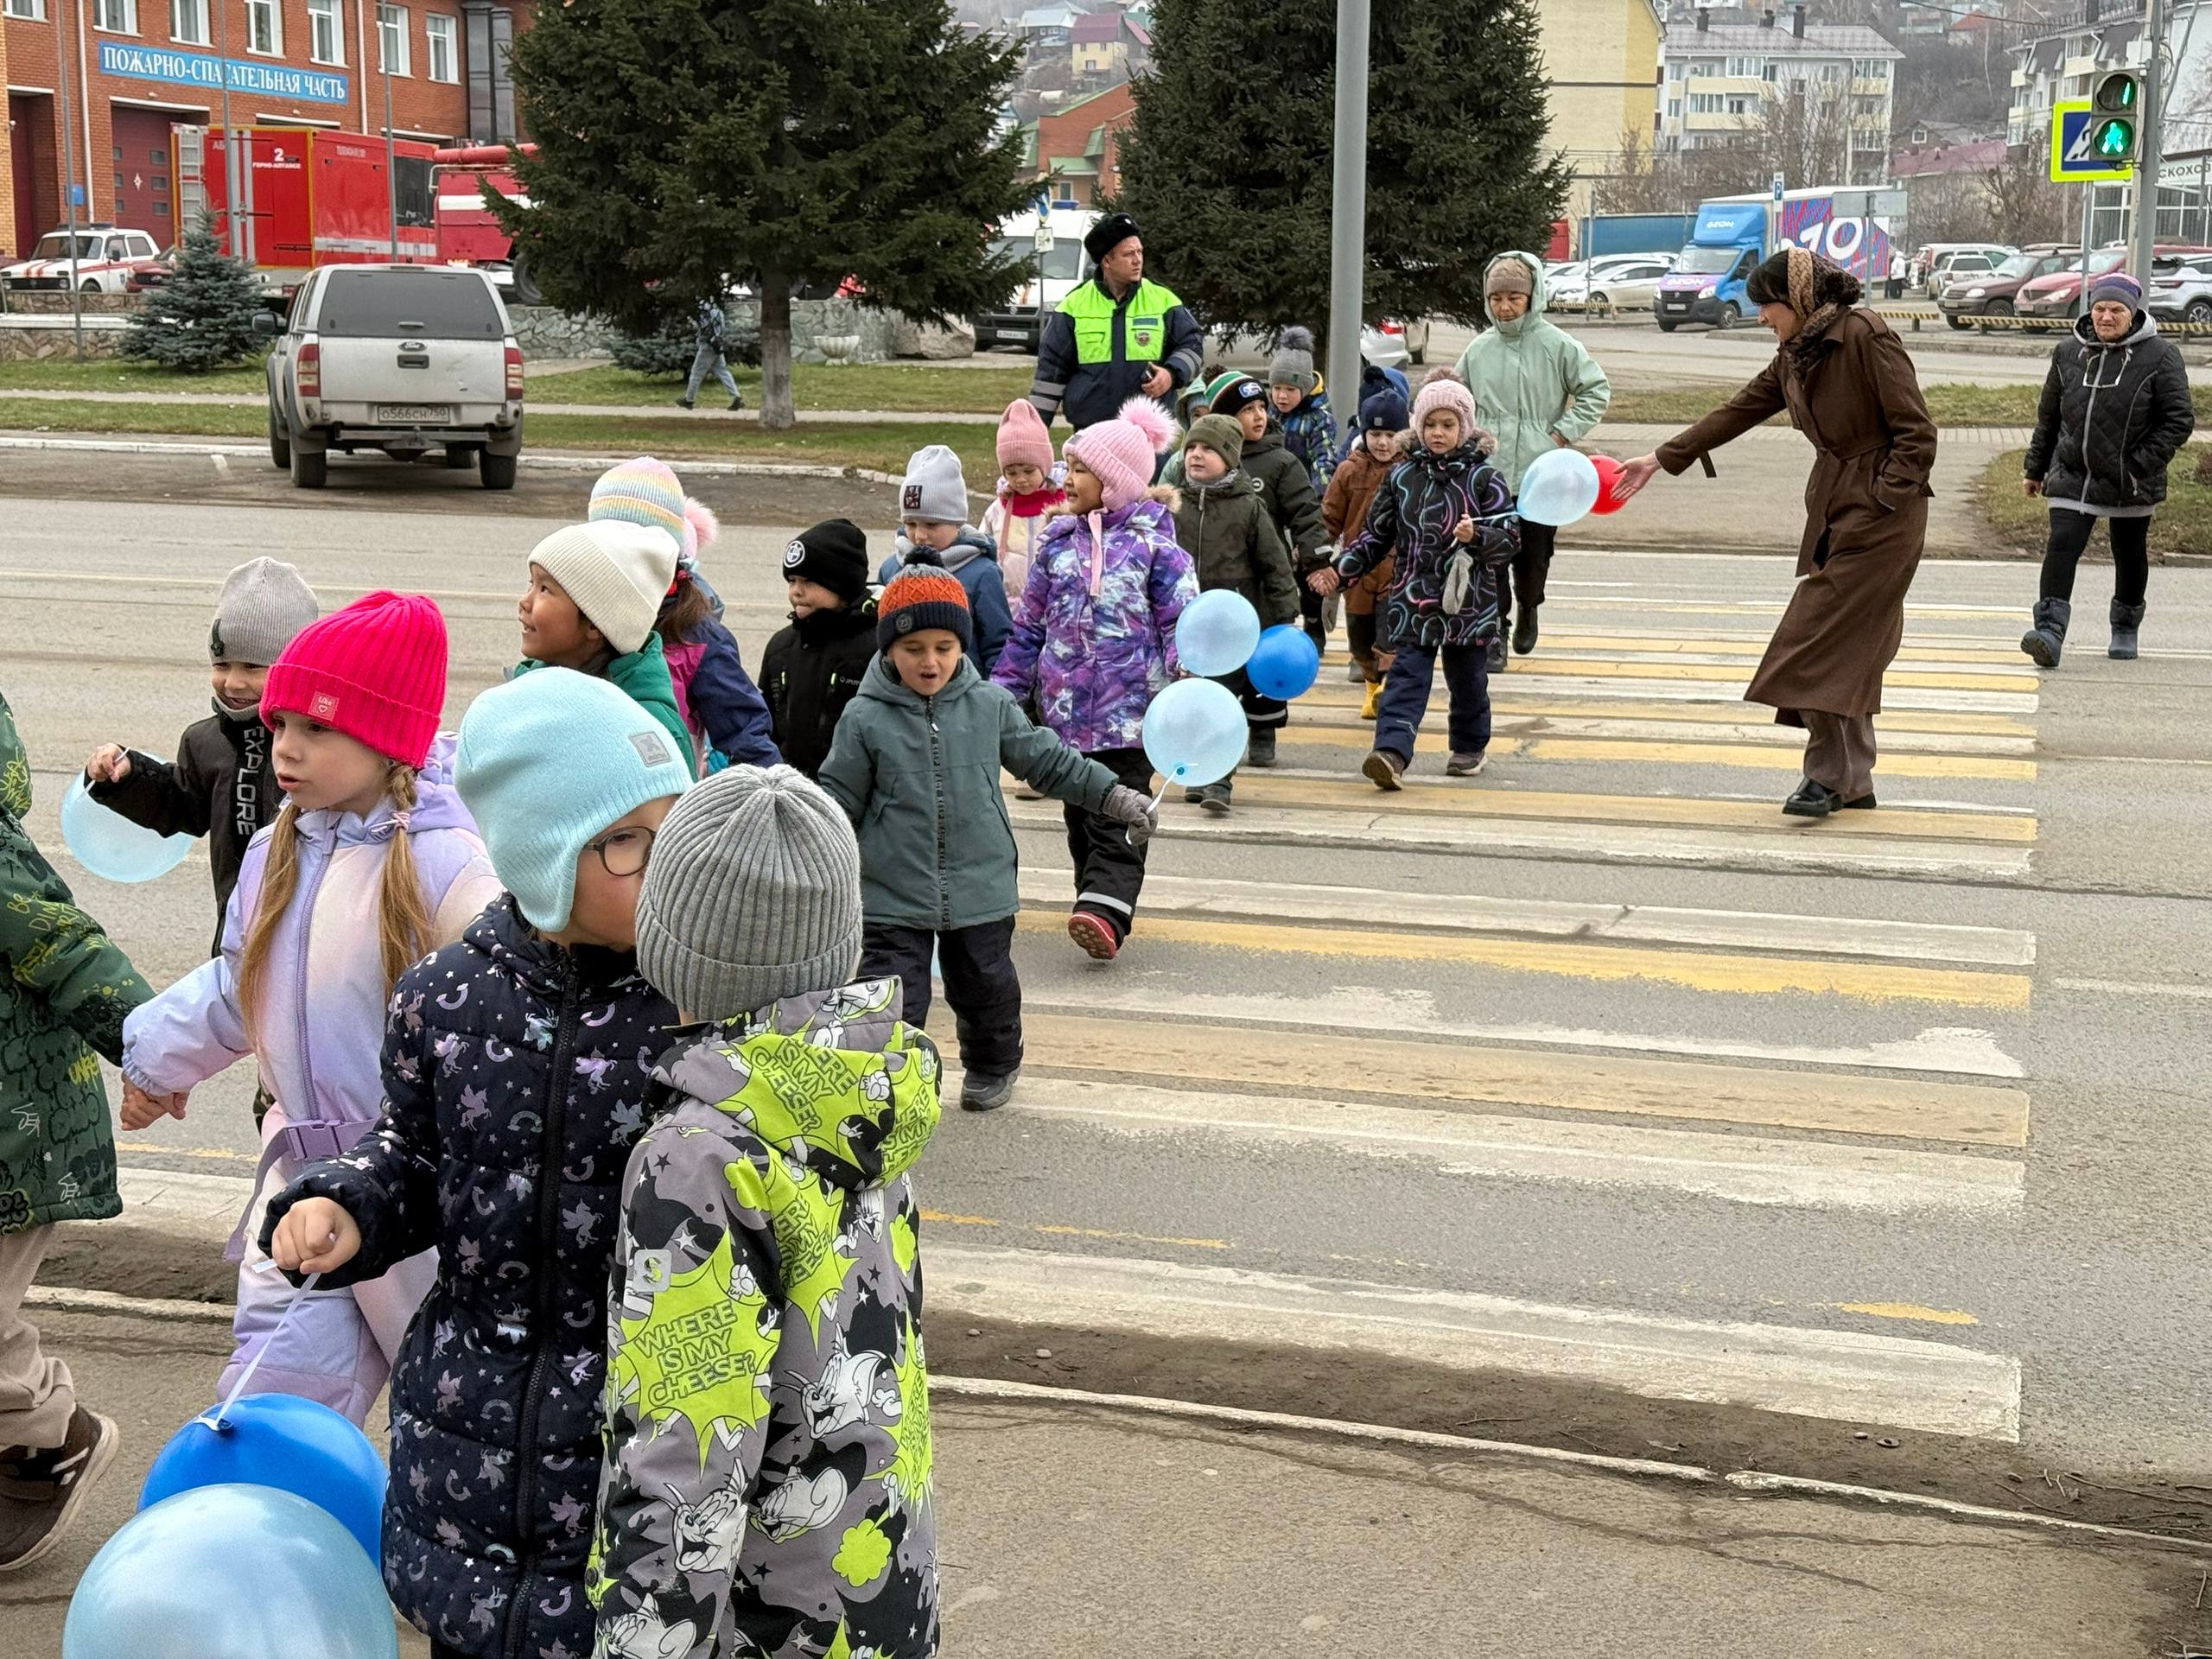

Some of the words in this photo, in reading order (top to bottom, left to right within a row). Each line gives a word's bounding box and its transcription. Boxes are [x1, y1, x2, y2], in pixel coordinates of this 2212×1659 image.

[304, 75, 346, 100] ЧАСТЬ
[274, 147, 285, 162] 2
[236, 726, 265, 836] EXPLORE
[750, 1046, 823, 1135] CHEESE?
[792, 1057, 835, 1102] MY
[633, 1299, 738, 1358] WHERE
[657, 1348, 683, 1377] IS
[683, 1327, 733, 1367] MY
[648, 1350, 756, 1408] CHEESE?
